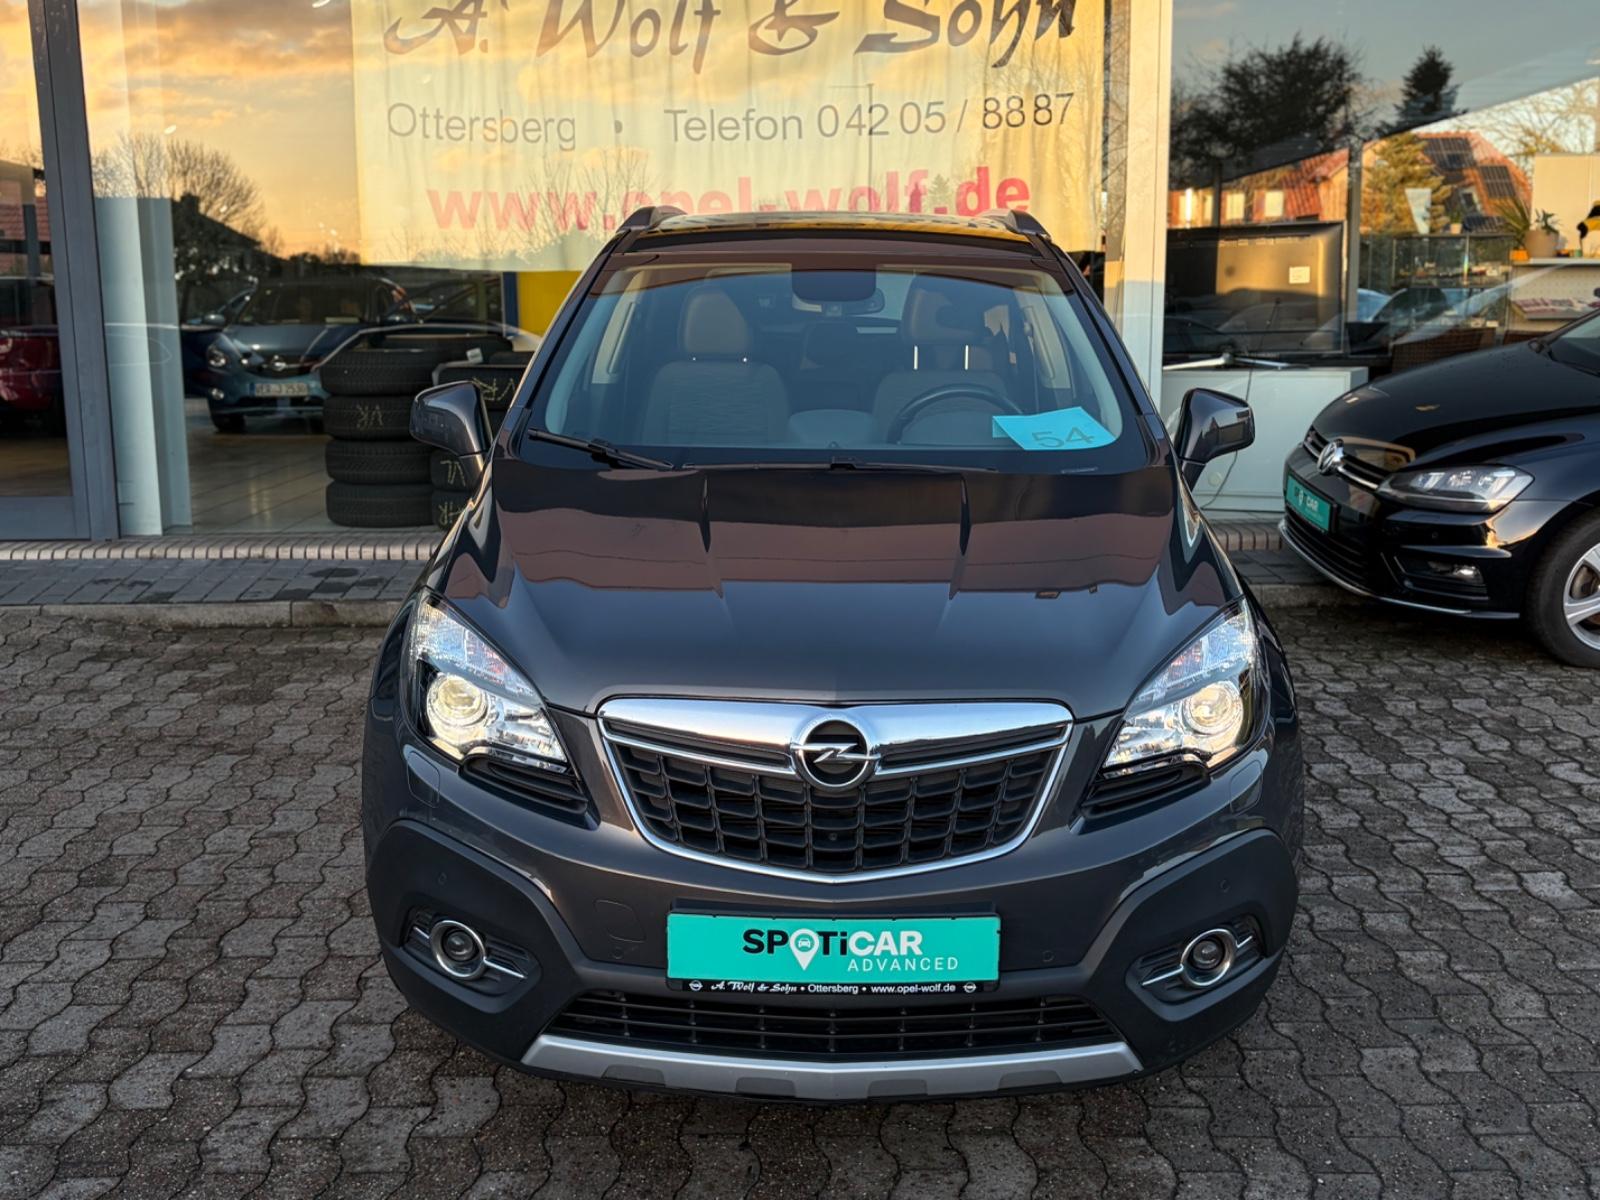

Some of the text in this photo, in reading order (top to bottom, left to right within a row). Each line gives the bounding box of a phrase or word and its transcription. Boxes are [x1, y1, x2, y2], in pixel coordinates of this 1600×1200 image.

[504, 0, 723, 74] Wolf
[748, 0, 840, 56] &
[853, 0, 1076, 68] Sohn
[387, 102, 576, 151] Ottersberg
[664, 108, 803, 142] Telefon
[1031, 426, 1095, 448] 54
[847, 956, 959, 972] ADVANCED
[728, 981, 755, 993] Wolf
[757, 982, 769, 992] &
[769, 983, 797, 995] Sohn
[807, 983, 859, 995] Ottersberg
[870, 983, 956, 995] www.opel-wolf.de
